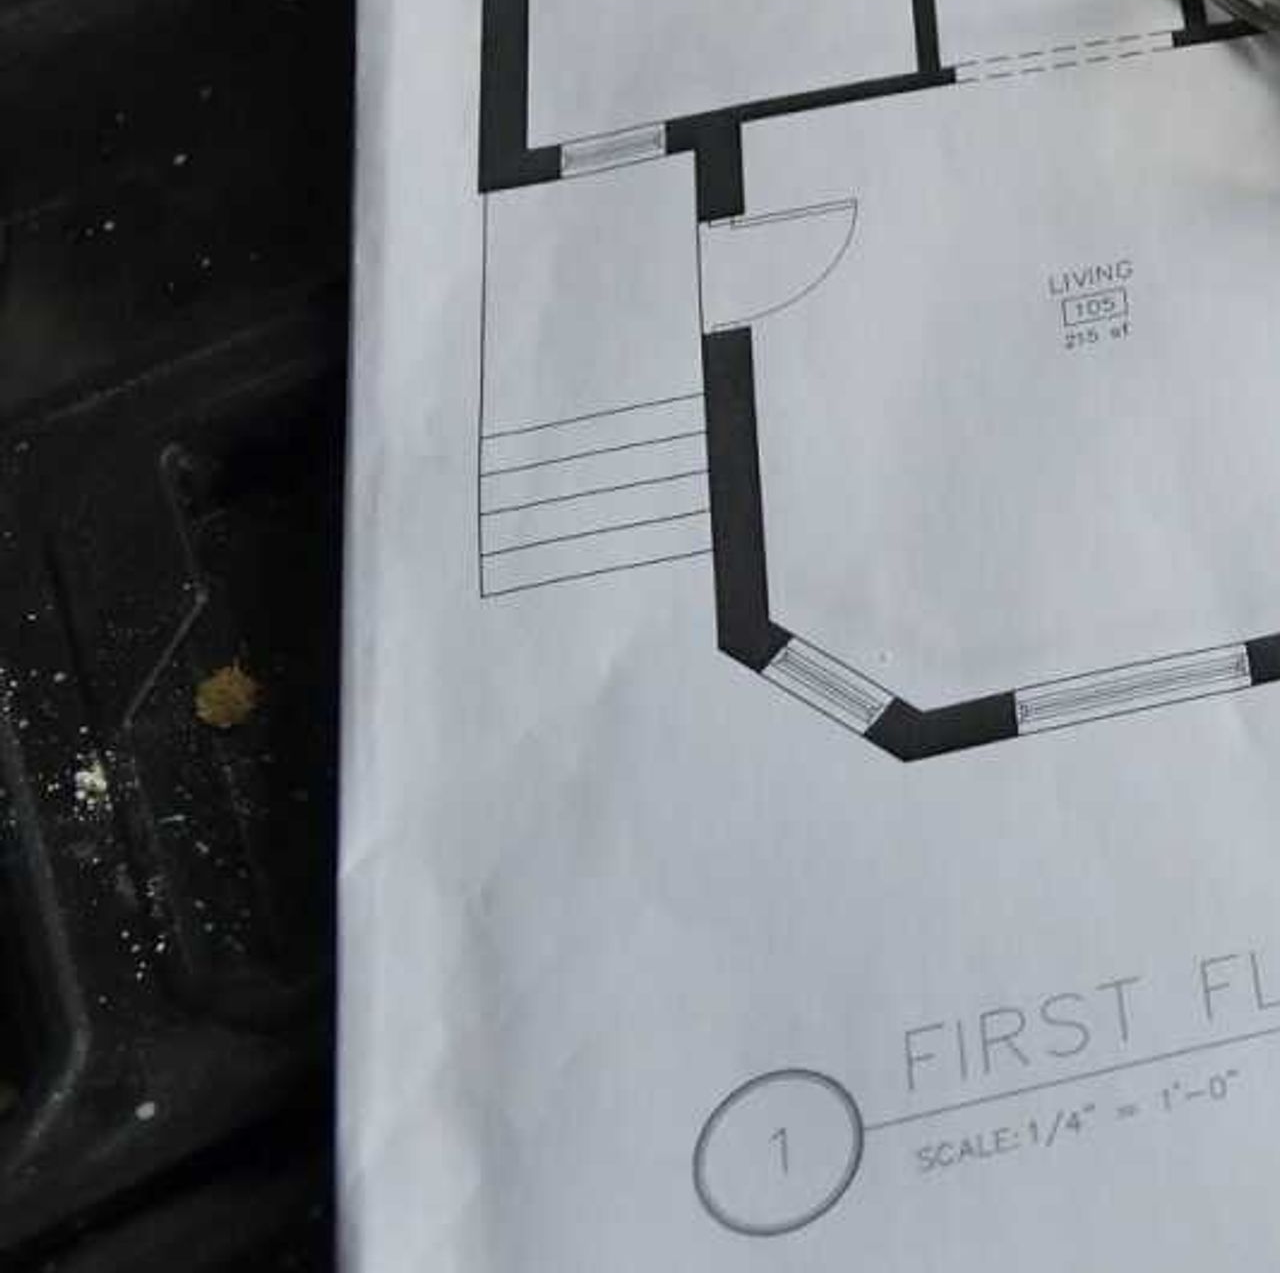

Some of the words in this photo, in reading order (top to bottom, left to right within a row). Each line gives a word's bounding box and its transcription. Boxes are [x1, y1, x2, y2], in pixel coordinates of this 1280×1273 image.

[1048, 259, 1134, 296] LIVING
[1075, 296, 1116, 318] 105
[903, 976, 1142, 1092] FIRST
[770, 1127, 791, 1176] 1
